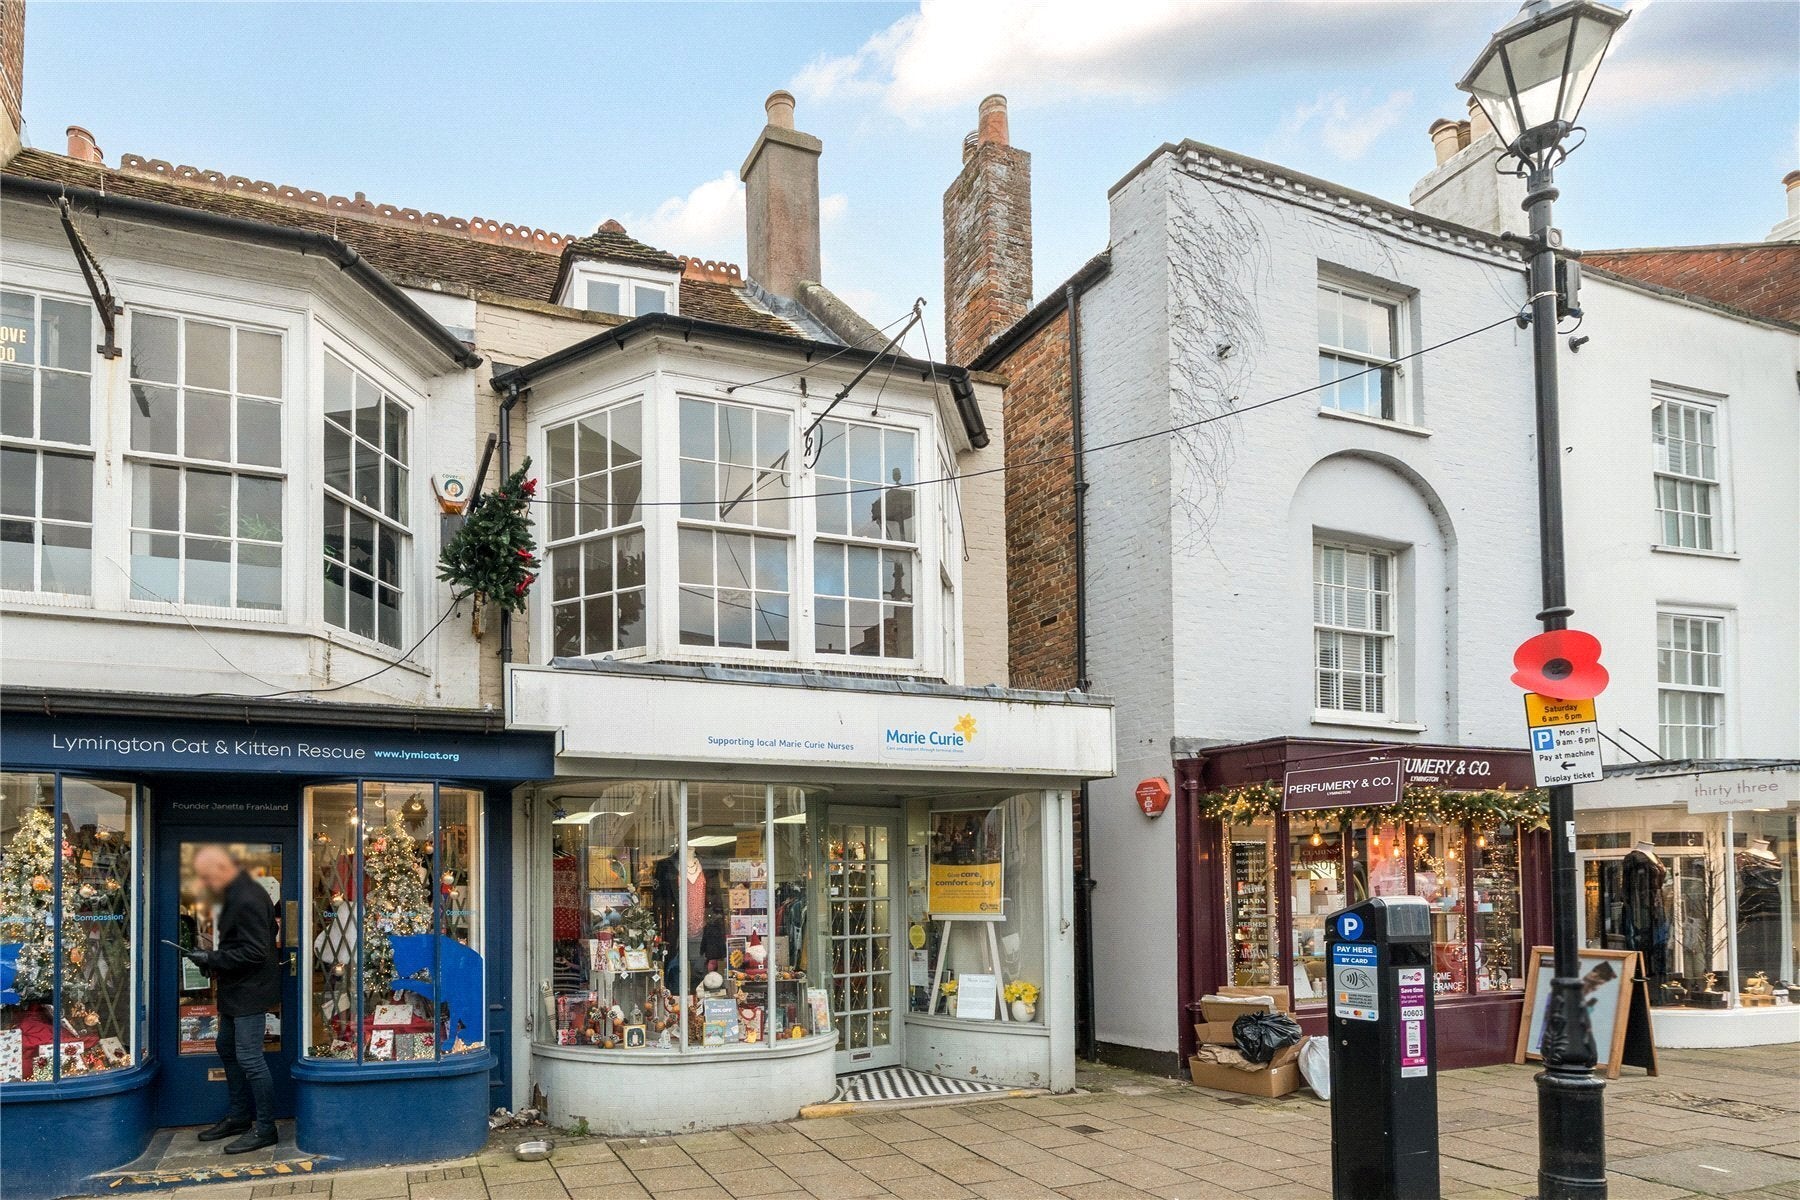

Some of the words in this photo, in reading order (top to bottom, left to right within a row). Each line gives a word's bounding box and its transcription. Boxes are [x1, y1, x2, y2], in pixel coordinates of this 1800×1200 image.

[0, 326, 26, 344] OVE
[1544, 704, 1578, 713] Saturday
[707, 736, 755, 748] Supporting
[757, 737, 777, 746] local
[779, 739, 802, 748] Marie
[804, 740, 825, 749] Curie
[827, 741, 855, 750] Nurses
[886, 729, 926, 744] Marie
[929, 731, 964, 746] Curie
[1537, 731, 1551, 749] P
[53, 733, 165, 754] Lymington
[171, 738, 210, 754] Cat
[215, 740, 229, 755] &
[235, 741, 291, 756] Kitten
[298, 743, 366, 759] Rescue
[374, 750, 460, 762] www.lymicat.org
[1564, 750, 1595, 758] machine
[1457, 760, 1466, 775] &
[1469, 760, 1492, 776] CO.
[1544, 774, 1571, 783] Display
[1573, 771, 1595, 779] ticket
[1289, 779, 1359, 794] PERFUMERY
[1361, 779, 1370, 788] &
[1372, 776, 1394, 787] CO.
[1694, 783, 1732, 797] thirty
[1737, 779, 1779, 793] three
[172, 802, 209, 810] Founder
[211, 803, 245, 811] Janette
[246, 803, 289, 811] Frankland
[981, 878, 995, 887] joy
[73, 913, 124, 922] Compassion
[1344, 917, 1358, 936] P
[1352, 946, 1373, 954] HERE
[1403, 1009, 1424, 1017] 40603
